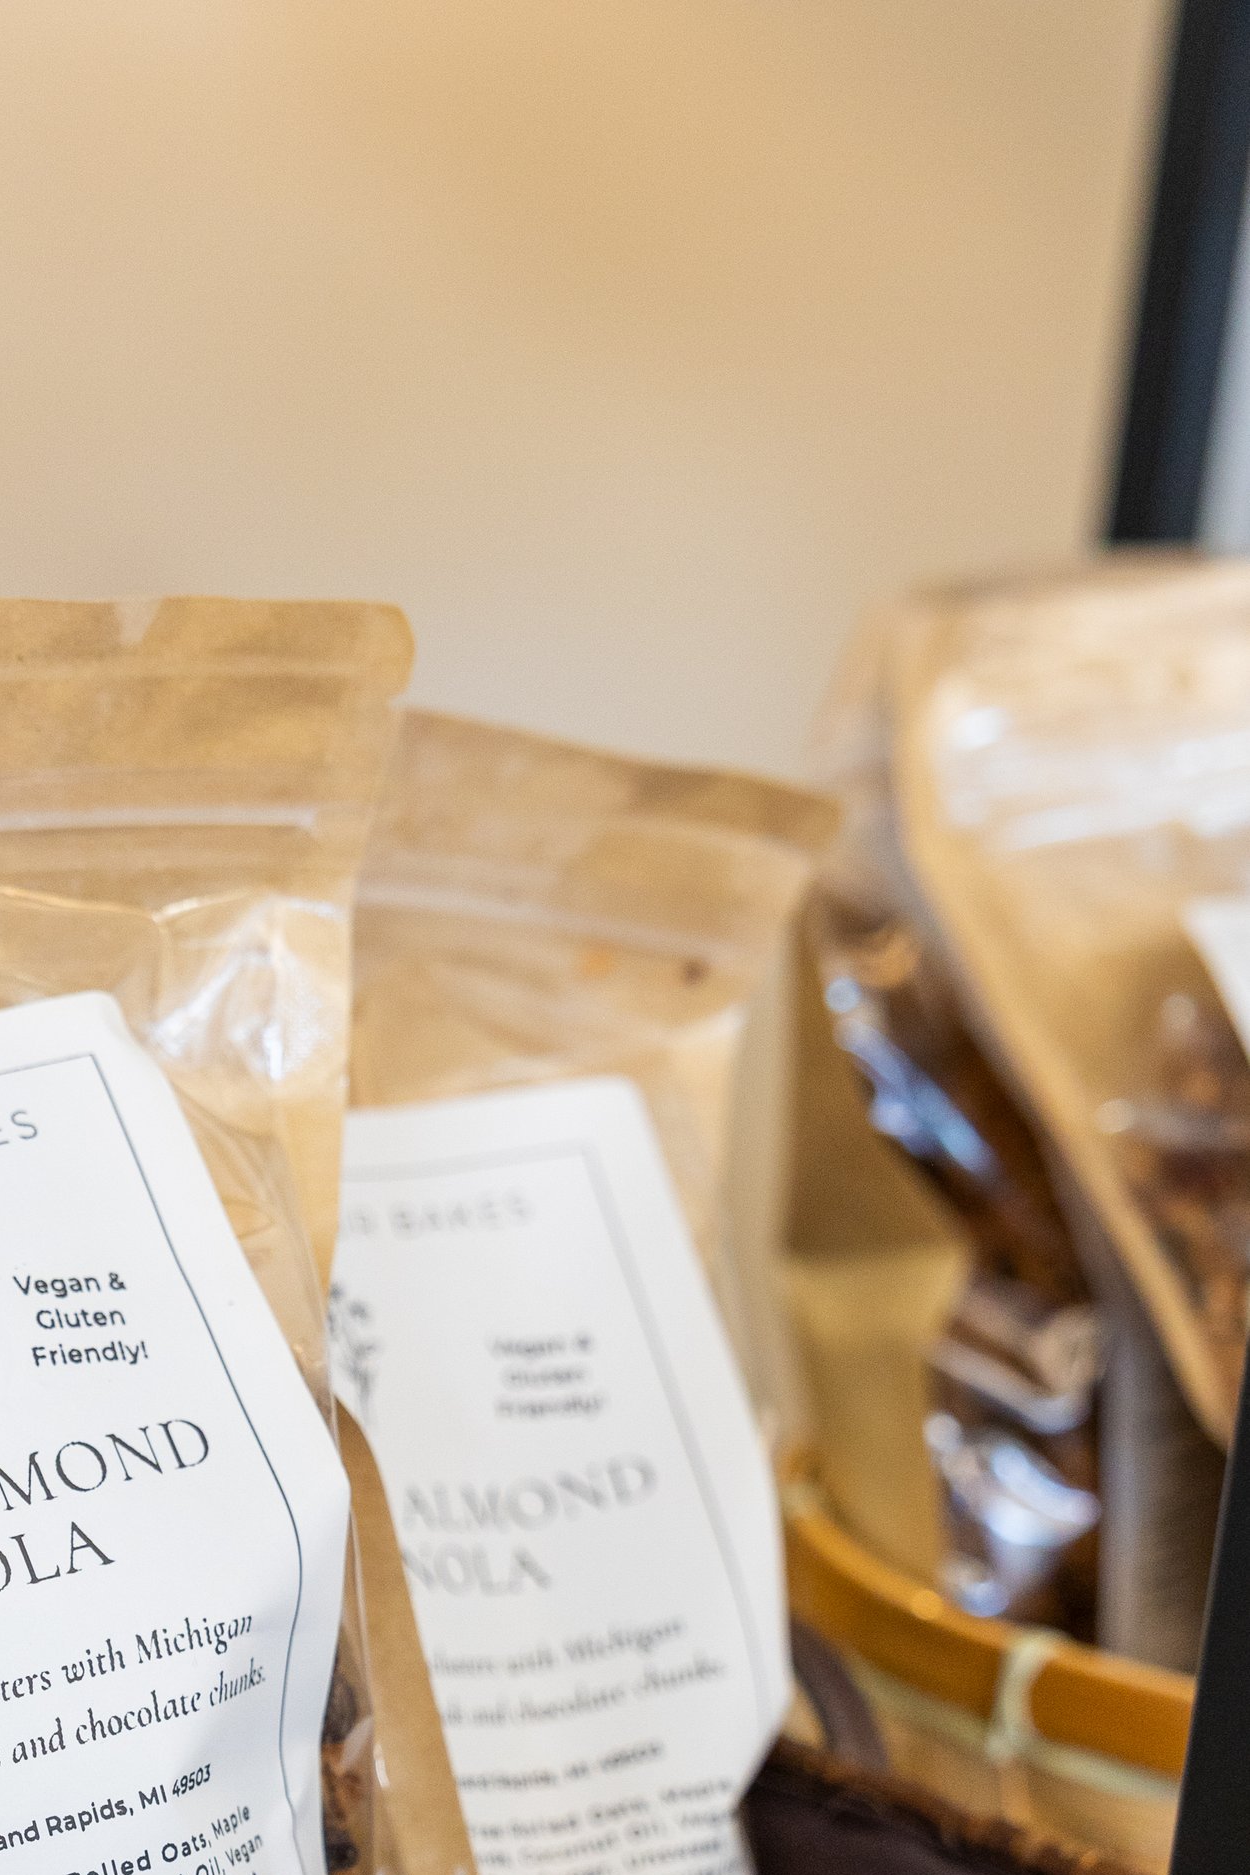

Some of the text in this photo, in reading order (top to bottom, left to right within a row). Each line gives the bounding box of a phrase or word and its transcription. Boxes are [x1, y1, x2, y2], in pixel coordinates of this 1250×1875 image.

[11, 1271, 128, 1299] Vegan &
[34, 1308, 127, 1331] Gluten
[30, 1339, 150, 1368] Friendly!
[402, 1541, 554, 1597] NOLA
[60, 1637, 127, 1685] with
[134, 1614, 253, 1665] Michigan
[11, 1716, 67, 1765] and
[75, 1688, 202, 1746] chocolate
[208, 1656, 266, 1708] chunks.
[44, 1798, 135, 1837] Rapids,
[137, 1784, 168, 1810] MI
[171, 1762, 212, 1798] 49503
[160, 1832, 212, 1864] Oats,
[210, 1805, 251, 1840] Maple
[224, 1834, 264, 1867] Vegan
